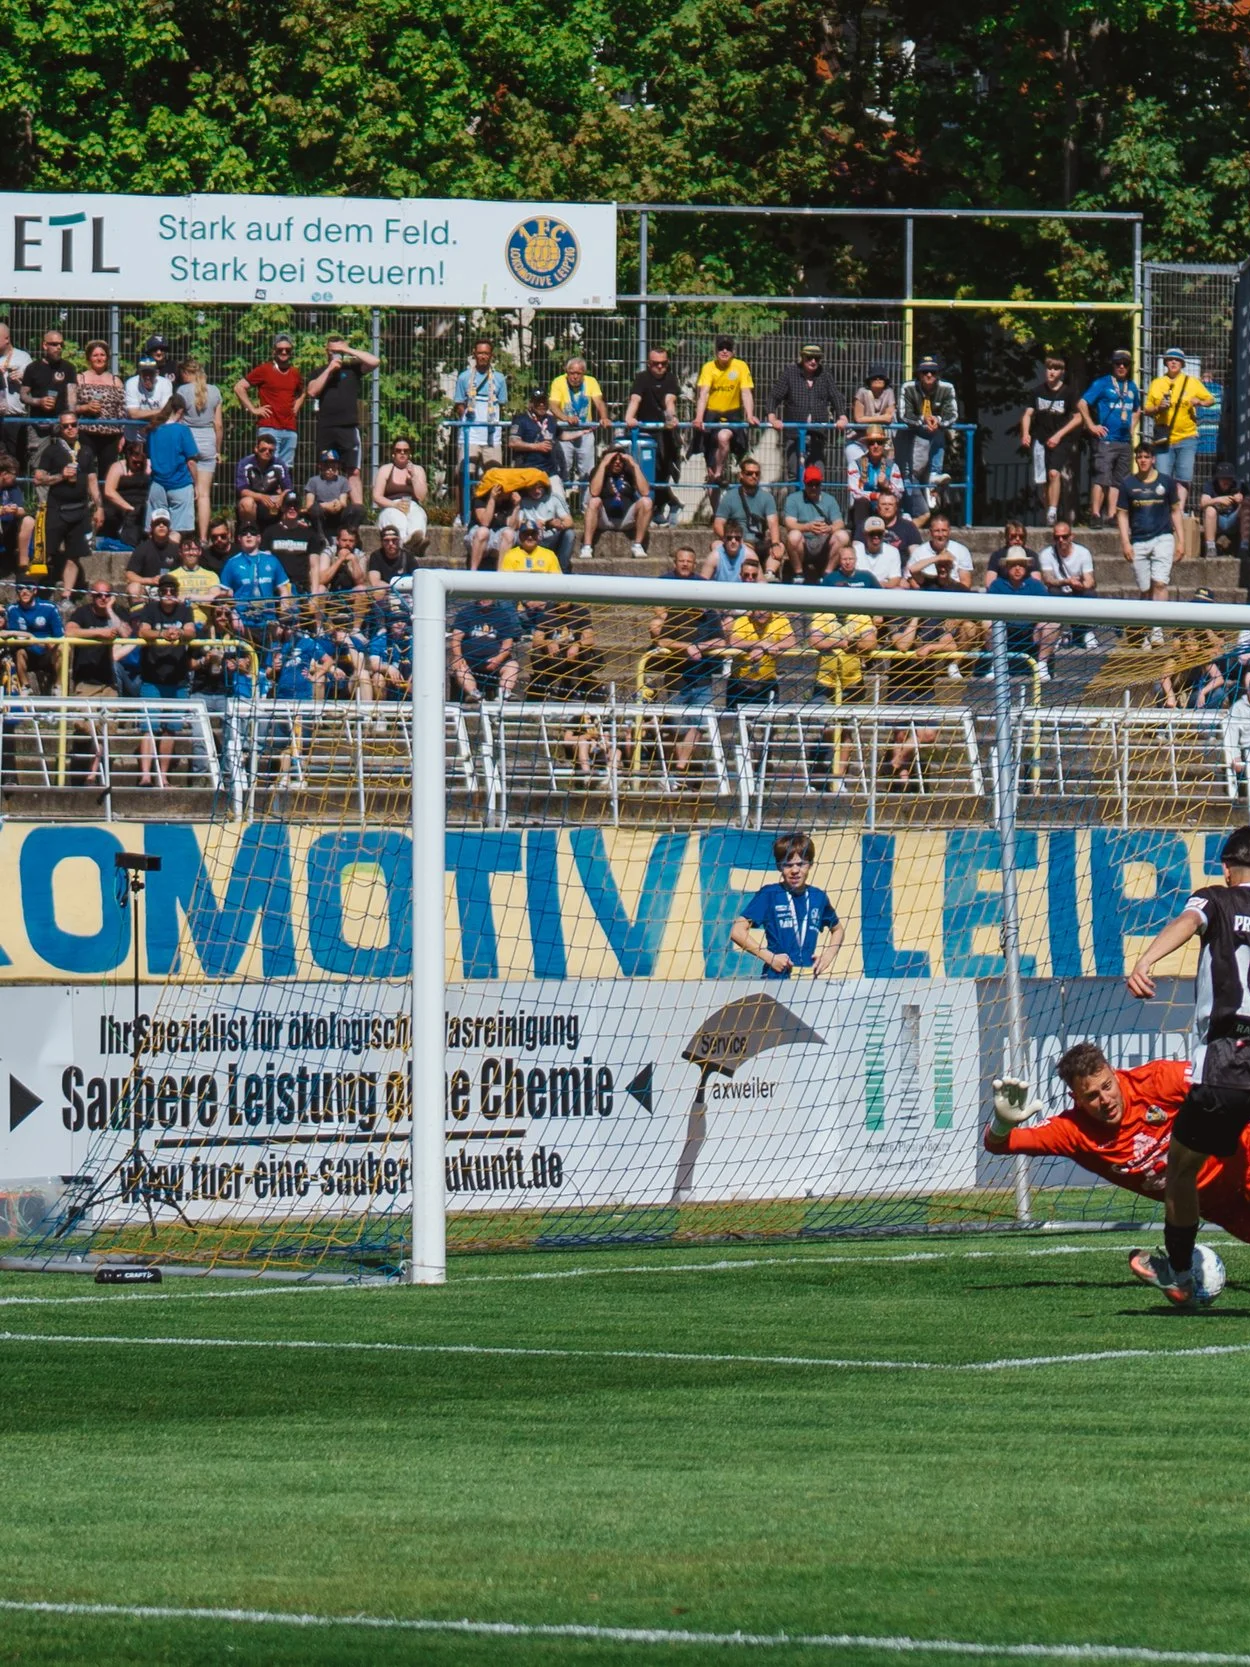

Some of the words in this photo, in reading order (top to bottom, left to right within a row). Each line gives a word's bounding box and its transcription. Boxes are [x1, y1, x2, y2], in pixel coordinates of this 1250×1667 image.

[14, 211, 120, 273] ETL
[158, 213, 236, 241] Stark
[246, 216, 294, 242] auf
[303, 217, 373, 243] dem
[385, 218, 457, 245] Feld.
[170, 255, 248, 281] Stark
[259, 256, 304, 283] bei
[316, 258, 444, 286] Steuern!
[553, 246, 576, 282] LEIPZIG
[100, 1015, 132, 1054] Ihr
[136, 1013, 248, 1057] Spezialist
[253, 1010, 284, 1051] für
[288, 1010, 413, 1055] ökologisch
[444, 1010, 579, 1051] lasreinigung
[701, 1031, 747, 1055] Service
[61, 1064, 218, 1133] Saubere
[228, 1062, 376, 1131] Leistung
[480, 1056, 614, 1121] Chemie
[712, 1076, 776, 1100] axweiler
